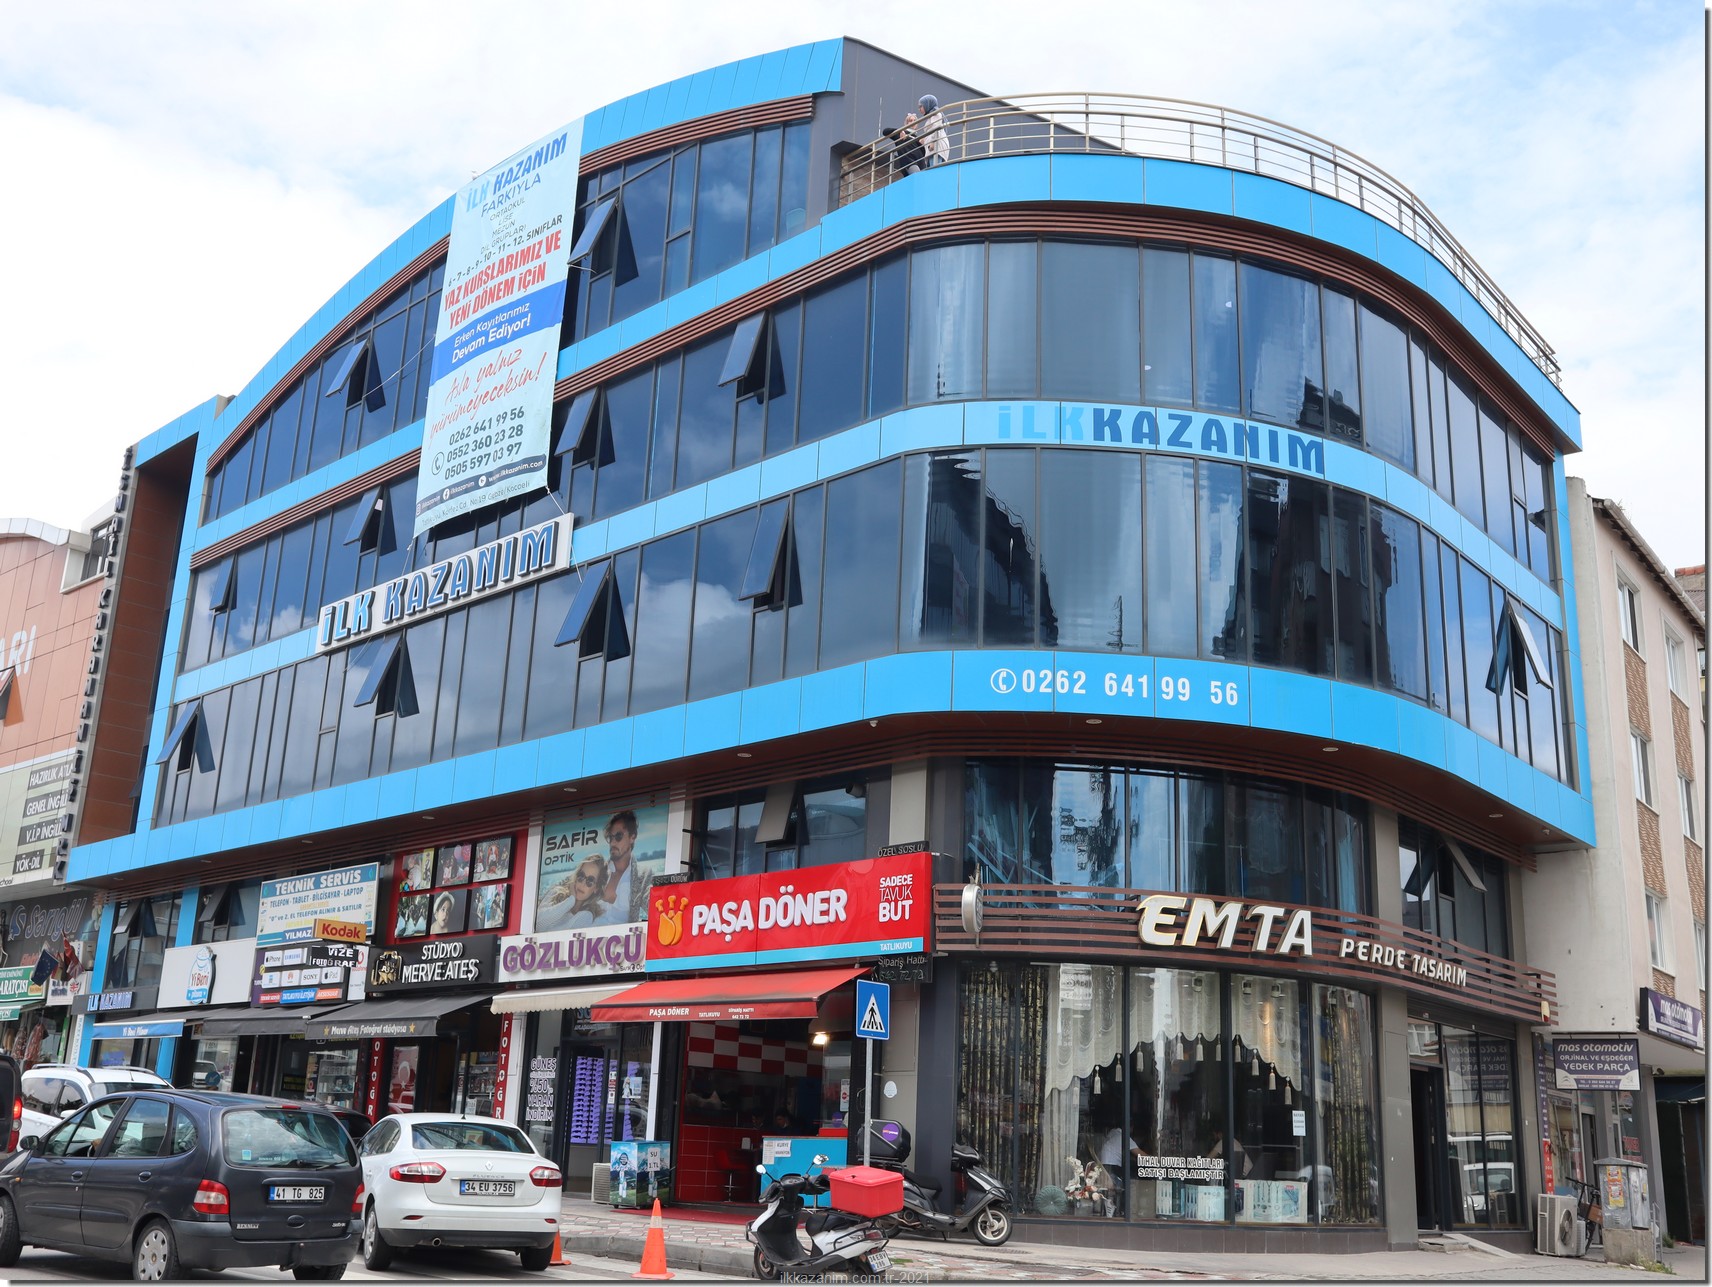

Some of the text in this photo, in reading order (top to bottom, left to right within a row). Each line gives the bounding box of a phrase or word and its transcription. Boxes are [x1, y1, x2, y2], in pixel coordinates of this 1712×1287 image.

[493, 132, 567, 195] KAZANIM
[481, 173, 541, 217] FARKIYLA
[490, 197, 525, 221] ORTAOKUL
[526, 214, 563, 241] SINIFLAR
[445, 229, 562, 312] YAZ KURSLARIMIZ VE
[450, 300, 472, 329] YENİ
[472, 276, 516, 314] DÖNEM
[454, 303, 530, 348] Erken Kayıtlarımız
[451, 313, 531, 364] Devam Ediyor!
[449, 406, 525, 445] 0262 641 99 56
[447, 424, 524, 463] 0552 360 23 28
[445, 442, 522, 480] 0505 597 03 97
[321, 520, 559, 645] İLK KAZANIM
[1022, 669, 1238, 706] 0262 641 99 56
[545, 827, 599, 852] SAFİR
[544, 852, 575, 866] OPTİK
[878, 846, 896, 857] ÖZEL
[16, 851, 41, 873] YÖK-DİL
[275, 870, 361, 896] TEKNİK SERVİS
[880, 874, 913, 887] SADECE
[270, 898, 290, 908] TELEFON
[293, 895, 309, 905] TABLET
[344, 887, 364, 897] LAPTOP
[879, 886, 912, 901] TAVUK
[296, 910, 318, 919] TELEFON
[691, 884, 848, 942] PAŞA DÖNER
[878, 900, 913, 922] BUT
[285, 930, 312, 940] YILMAZ
[322, 923, 361, 939] Kodak
[502, 927, 644, 972] GÖZLÜKÇÜ
[880, 941, 912, 951] TATLIKUYU
[1136, 894, 1468, 988] EMTA PERDE TASARIM
[328, 947, 354, 958] VİZE
[422, 942, 463, 960] STÜDYO
[312, 957, 355, 967] FOTOĞRAF
[402, 959, 480, 983] MERVE ATEŞ
[649, 1006, 690, 1018] PAŞA DÖNER
[1558, 1042, 1634, 1052] mas otomotiv
[531, 1055, 557, 1071] GÜNEŞ
[1563, 1063, 1631, 1072] YEDEK PARÇA
[1601, 1054, 1634, 1062] EŞDEĞER
[528, 1094, 553, 1107] VARAN
[525, 1107, 554, 1121] İNDİRİM
[1137, 1154, 1224, 1170] İTHAL DUVAR KAĞITLARI
[1137, 1168, 1224, 1181] SATIŞI BAŞLAMIŞTIR
[276, 1188, 324, 1199] 41 TG 825
[465, 1182, 513, 1193] 34 EU 3756
